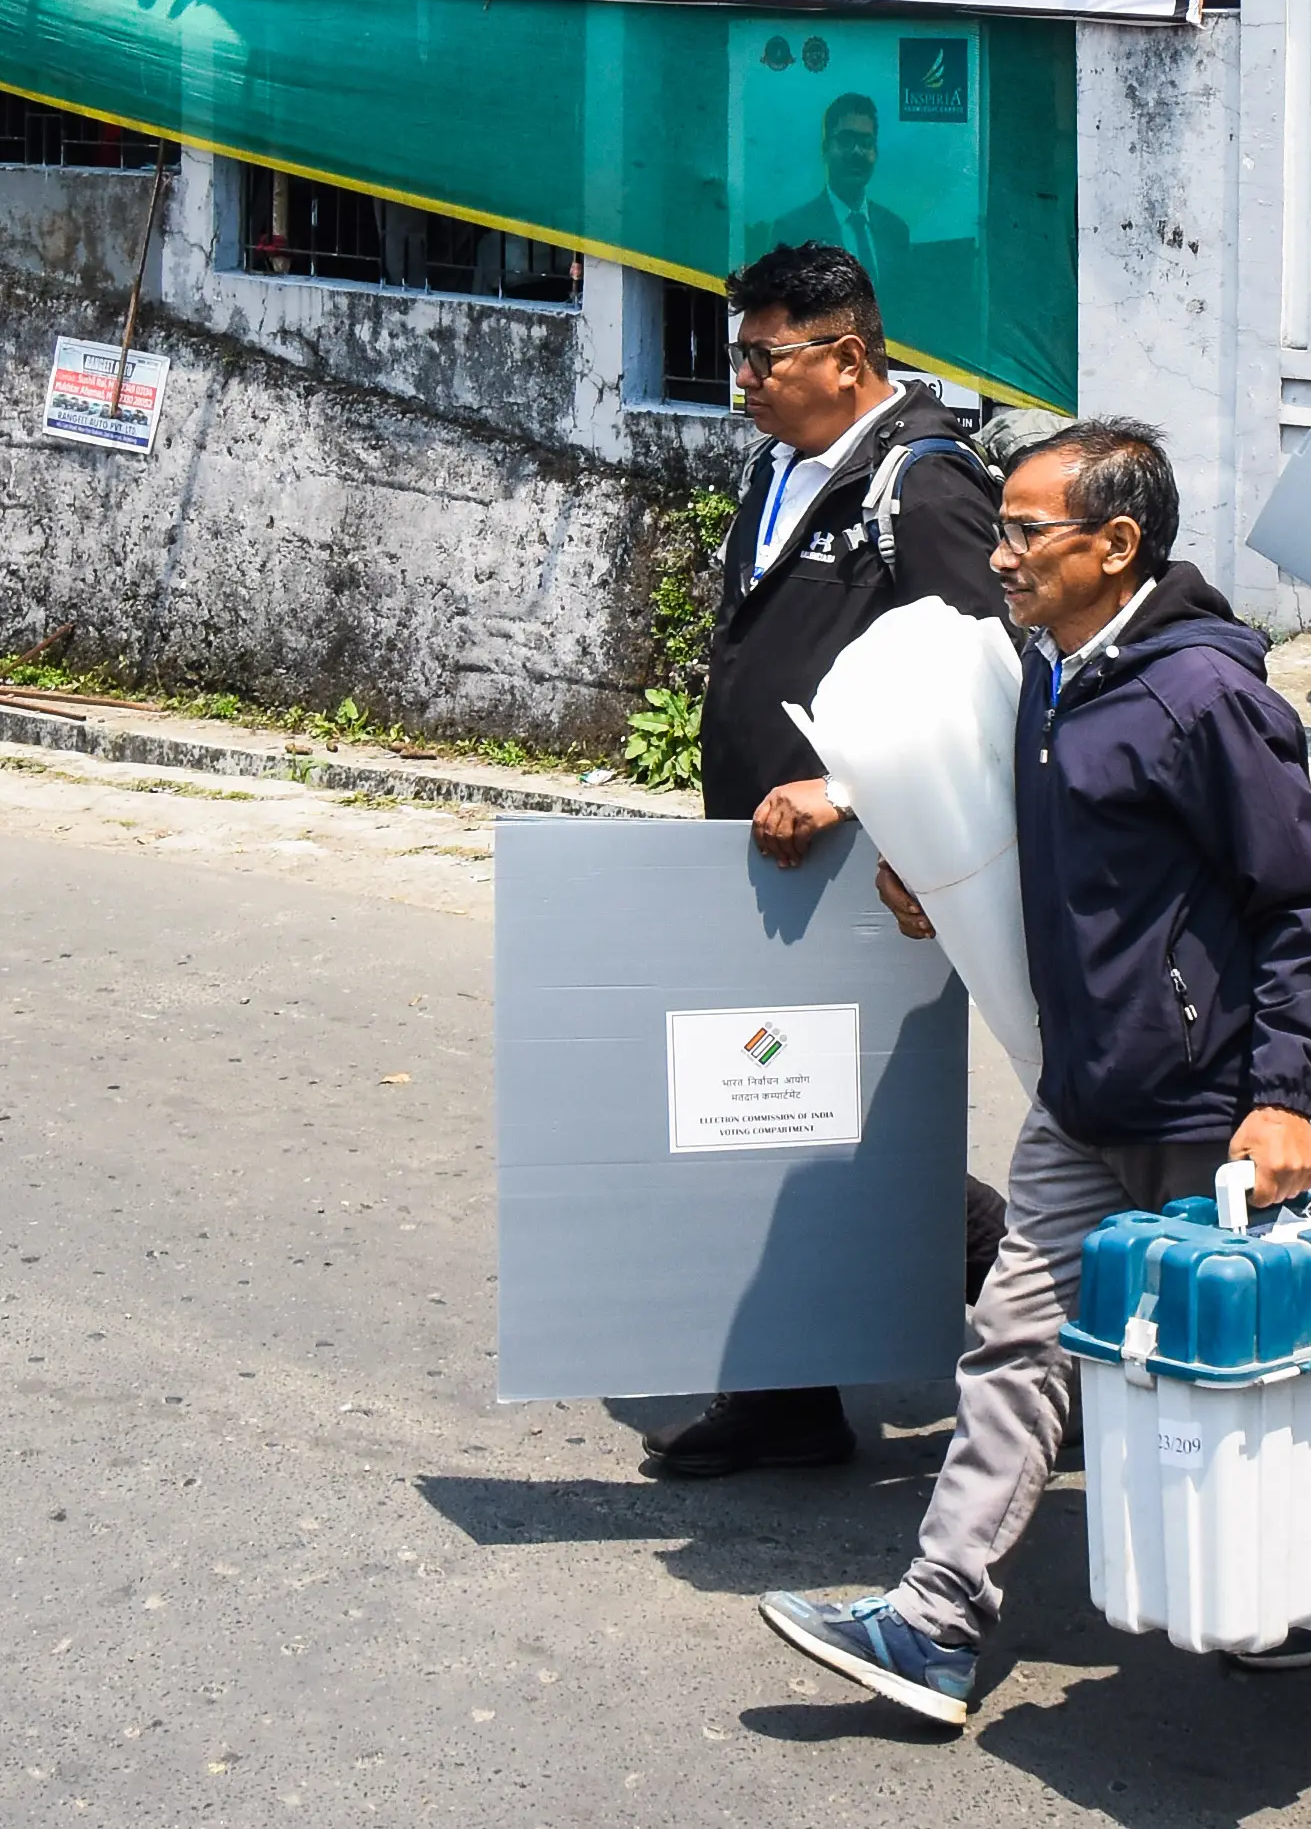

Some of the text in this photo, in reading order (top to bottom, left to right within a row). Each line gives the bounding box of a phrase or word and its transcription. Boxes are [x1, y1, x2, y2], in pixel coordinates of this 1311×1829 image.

[89, 416, 109, 428] AUTO
[722, 1073, 810, 1088] भारत निर्वाचन आयोग
[731, 1092, 759, 1102] मतदान
[699, 1110, 834, 1125] ELECTION COMMISSION OF INDIA
[719, 1124, 814, 1136] VOTING COMPARTMENT
[1158, 1433, 1201, 1455] 23/209
